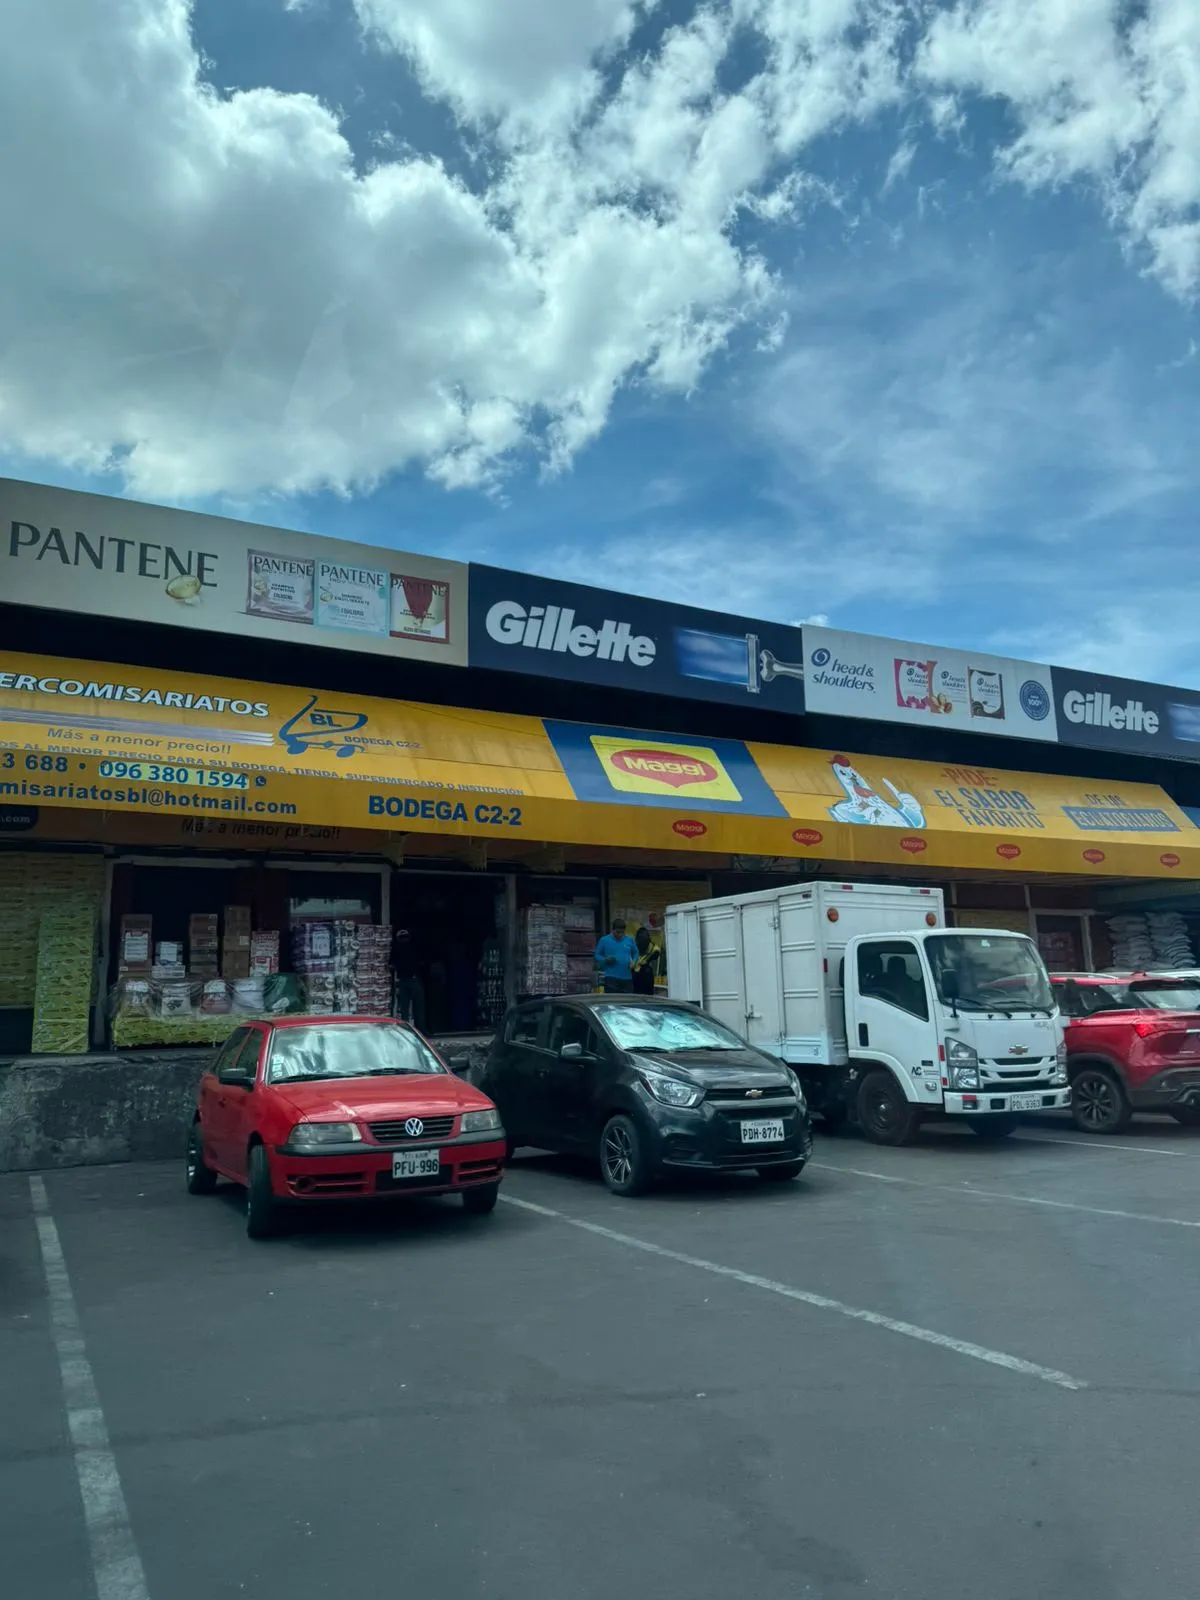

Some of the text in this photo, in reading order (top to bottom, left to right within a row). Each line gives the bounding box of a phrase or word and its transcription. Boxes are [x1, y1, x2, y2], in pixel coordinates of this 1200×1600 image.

[9, 521, 218, 587] PANTENE
[253, 556, 313, 577] PANTENE
[321, 564, 385, 587] PANTENE
[486, 600, 657, 667] Gillette
[812, 671, 875, 691] shoulders
[0, 671, 270, 718] ERCOMISARIATOS
[309, 713, 343, 728] BL
[1063, 689, 1159, 734] Gillette
[47, 727, 231, 755] Más a menor precio!!
[344, 735, 421, 749] BODEGA C2-2
[24, 743, 42, 752] AL
[47, 744, 104, 756] MENOR
[108, 749, 162, 762] PRECIO
[167, 754, 205, 766] PARA
[209, 759, 229, 769] SU
[346, 772, 443, 789] SUPERMERCADO
[25, 755, 69, 772] 688
[99, 760, 143, 780] 096
[148, 764, 189, 784] 380
[196, 768, 249, 790] 1594
[622, 756, 706, 777] Maggi
[0, 778, 297, 814] misariatosbl@hotmail.com
[933, 786, 1037, 810] EL SABOR
[368, 795, 523, 826] BODEGA C2-2
[957, 808, 1046, 828] FAVORITO
[232, 823, 280, 837] menor
[676, 823, 704, 834] Maggi
[743, 1127, 783, 1140] PDH-8774
[394, 1159, 438, 1176] PFU-996
